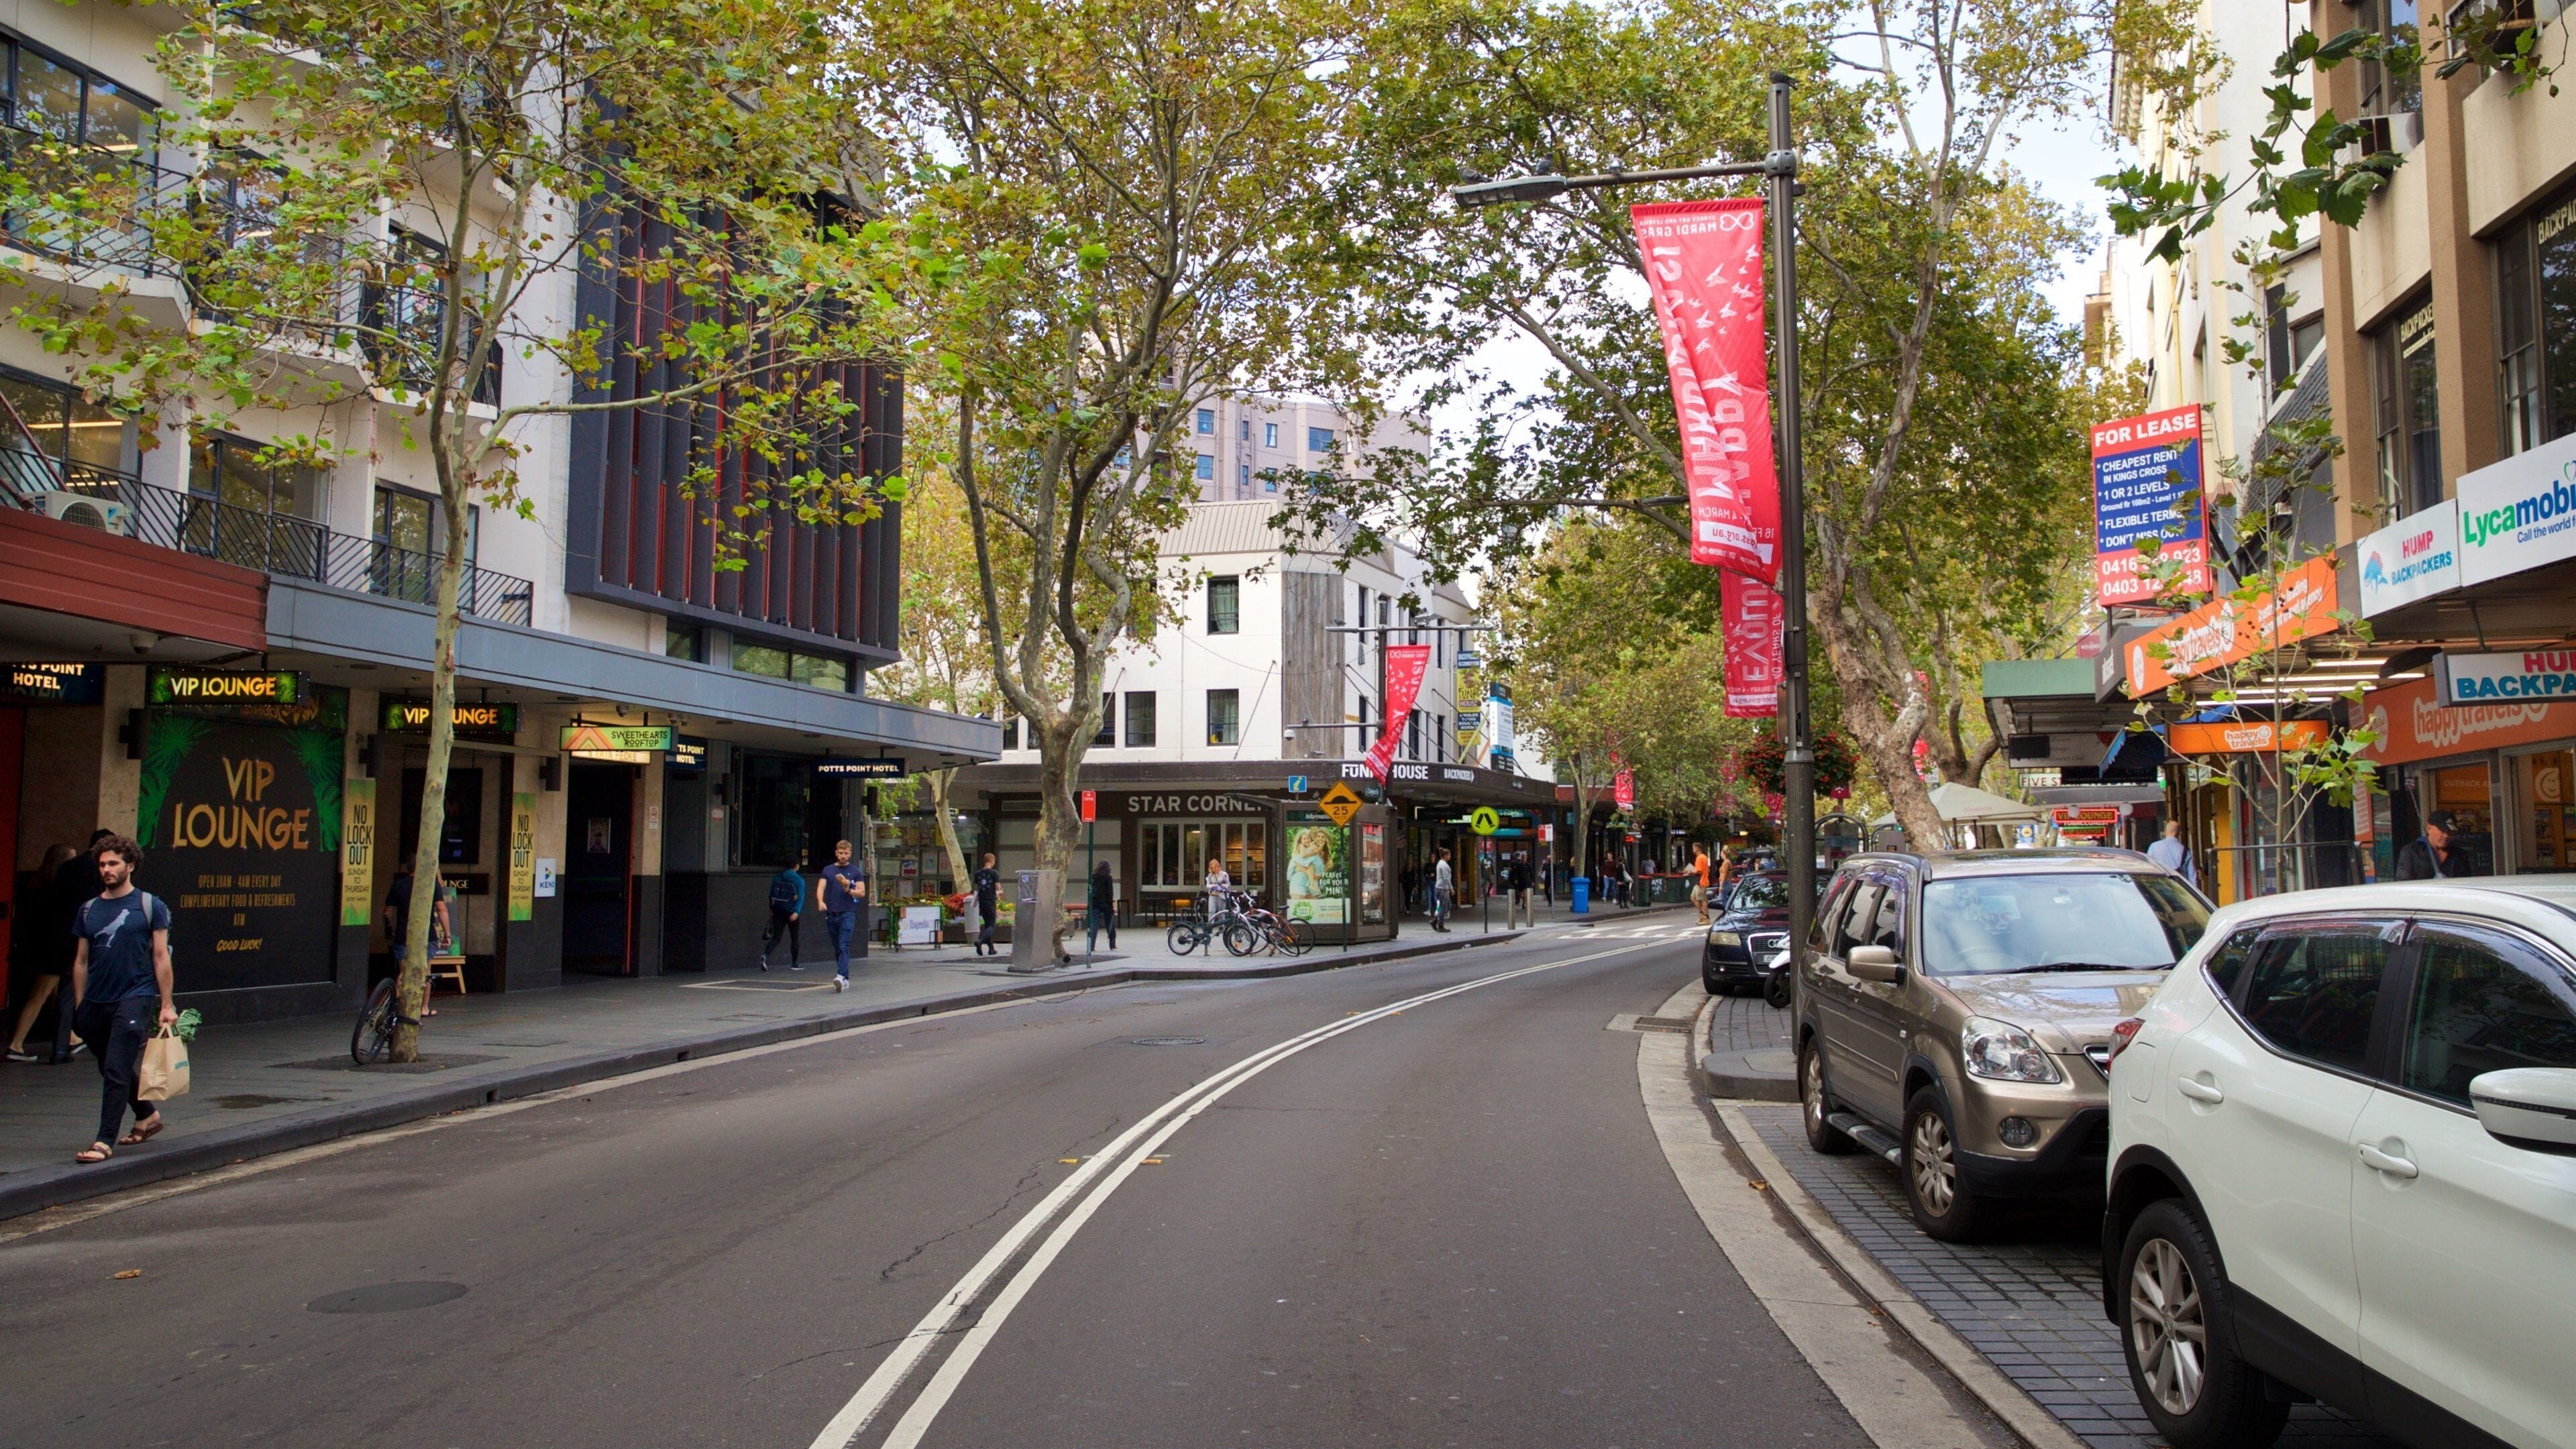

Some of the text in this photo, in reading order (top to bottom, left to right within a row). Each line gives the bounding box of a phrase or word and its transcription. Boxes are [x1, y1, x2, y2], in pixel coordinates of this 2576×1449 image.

[2094, 413, 2197, 447] FOR LEASE
[2102, 454, 2151, 473] CHEAPEST
[2103, 465, 2167, 484] IN KINGS CROSS
[2104, 489, 2109, 500] 1
[2111, 487, 2125, 499] OR
[2127, 486, 2133, 497] 2
[2135, 480, 2171, 496] LEVELS
[2100, 502, 2123, 513] Ground
[2155, 494, 2171, 504] Level
[2105, 513, 2149, 530] FLEXIBLE
[2517, 530, 2533, 543] Call
[2534, 527, 2547, 538] the
[2548, 517, 2571, 534] world
[2106, 533, 2133, 547] DON'T
[2402, 530, 2434, 559] HUMP
[2102, 556, 2138, 575] 0416
[2392, 551, 2453, 586] BACKPACKERS
[2103, 578, 2138, 597] 0403
[2524, 651, 2576, 673] HU
[13, 672, 60, 690] HOTEL
[170, 676, 277, 696] VIP LOUNGE
[2457, 674, 2576, 699] BACKPA
[404, 708, 498, 724] VIP UNGE
[611, 731, 668, 741] SWEETHEARTS
[2226, 731, 2267, 747] happy travels
[676, 755, 696, 764] HOTEL
[687, 747, 704, 755] POINT
[222, 757, 275, 802] VIP
[1392, 764, 1429, 780] HOUSE
[2021, 777, 2046, 787] FIVE
[2444, 779, 2480, 788] OUTBACK
[1128, 795, 1261, 812] STAR CORNE
[1333, 806, 1348, 815] 25
[354, 804, 368, 824] NO
[517, 814, 529, 831] NO
[172, 802, 311, 851] LOUNGE
[346, 825, 373, 845] LOCK
[513, 833, 534, 850] LOCK
[349, 846, 369, 865] OUT
[514, 851, 530, 868] OUT
[199, 875, 214, 888] OPEN
[252, 875, 269, 888] EVERY
[270, 875, 282, 888] DAY
[231, 894, 247, 907] FOOD
[254, 893, 296, 907] REFRESHMENTS
[233, 913, 246, 926] ATM
[216, 938, 263, 952] GOOD LUCK!
